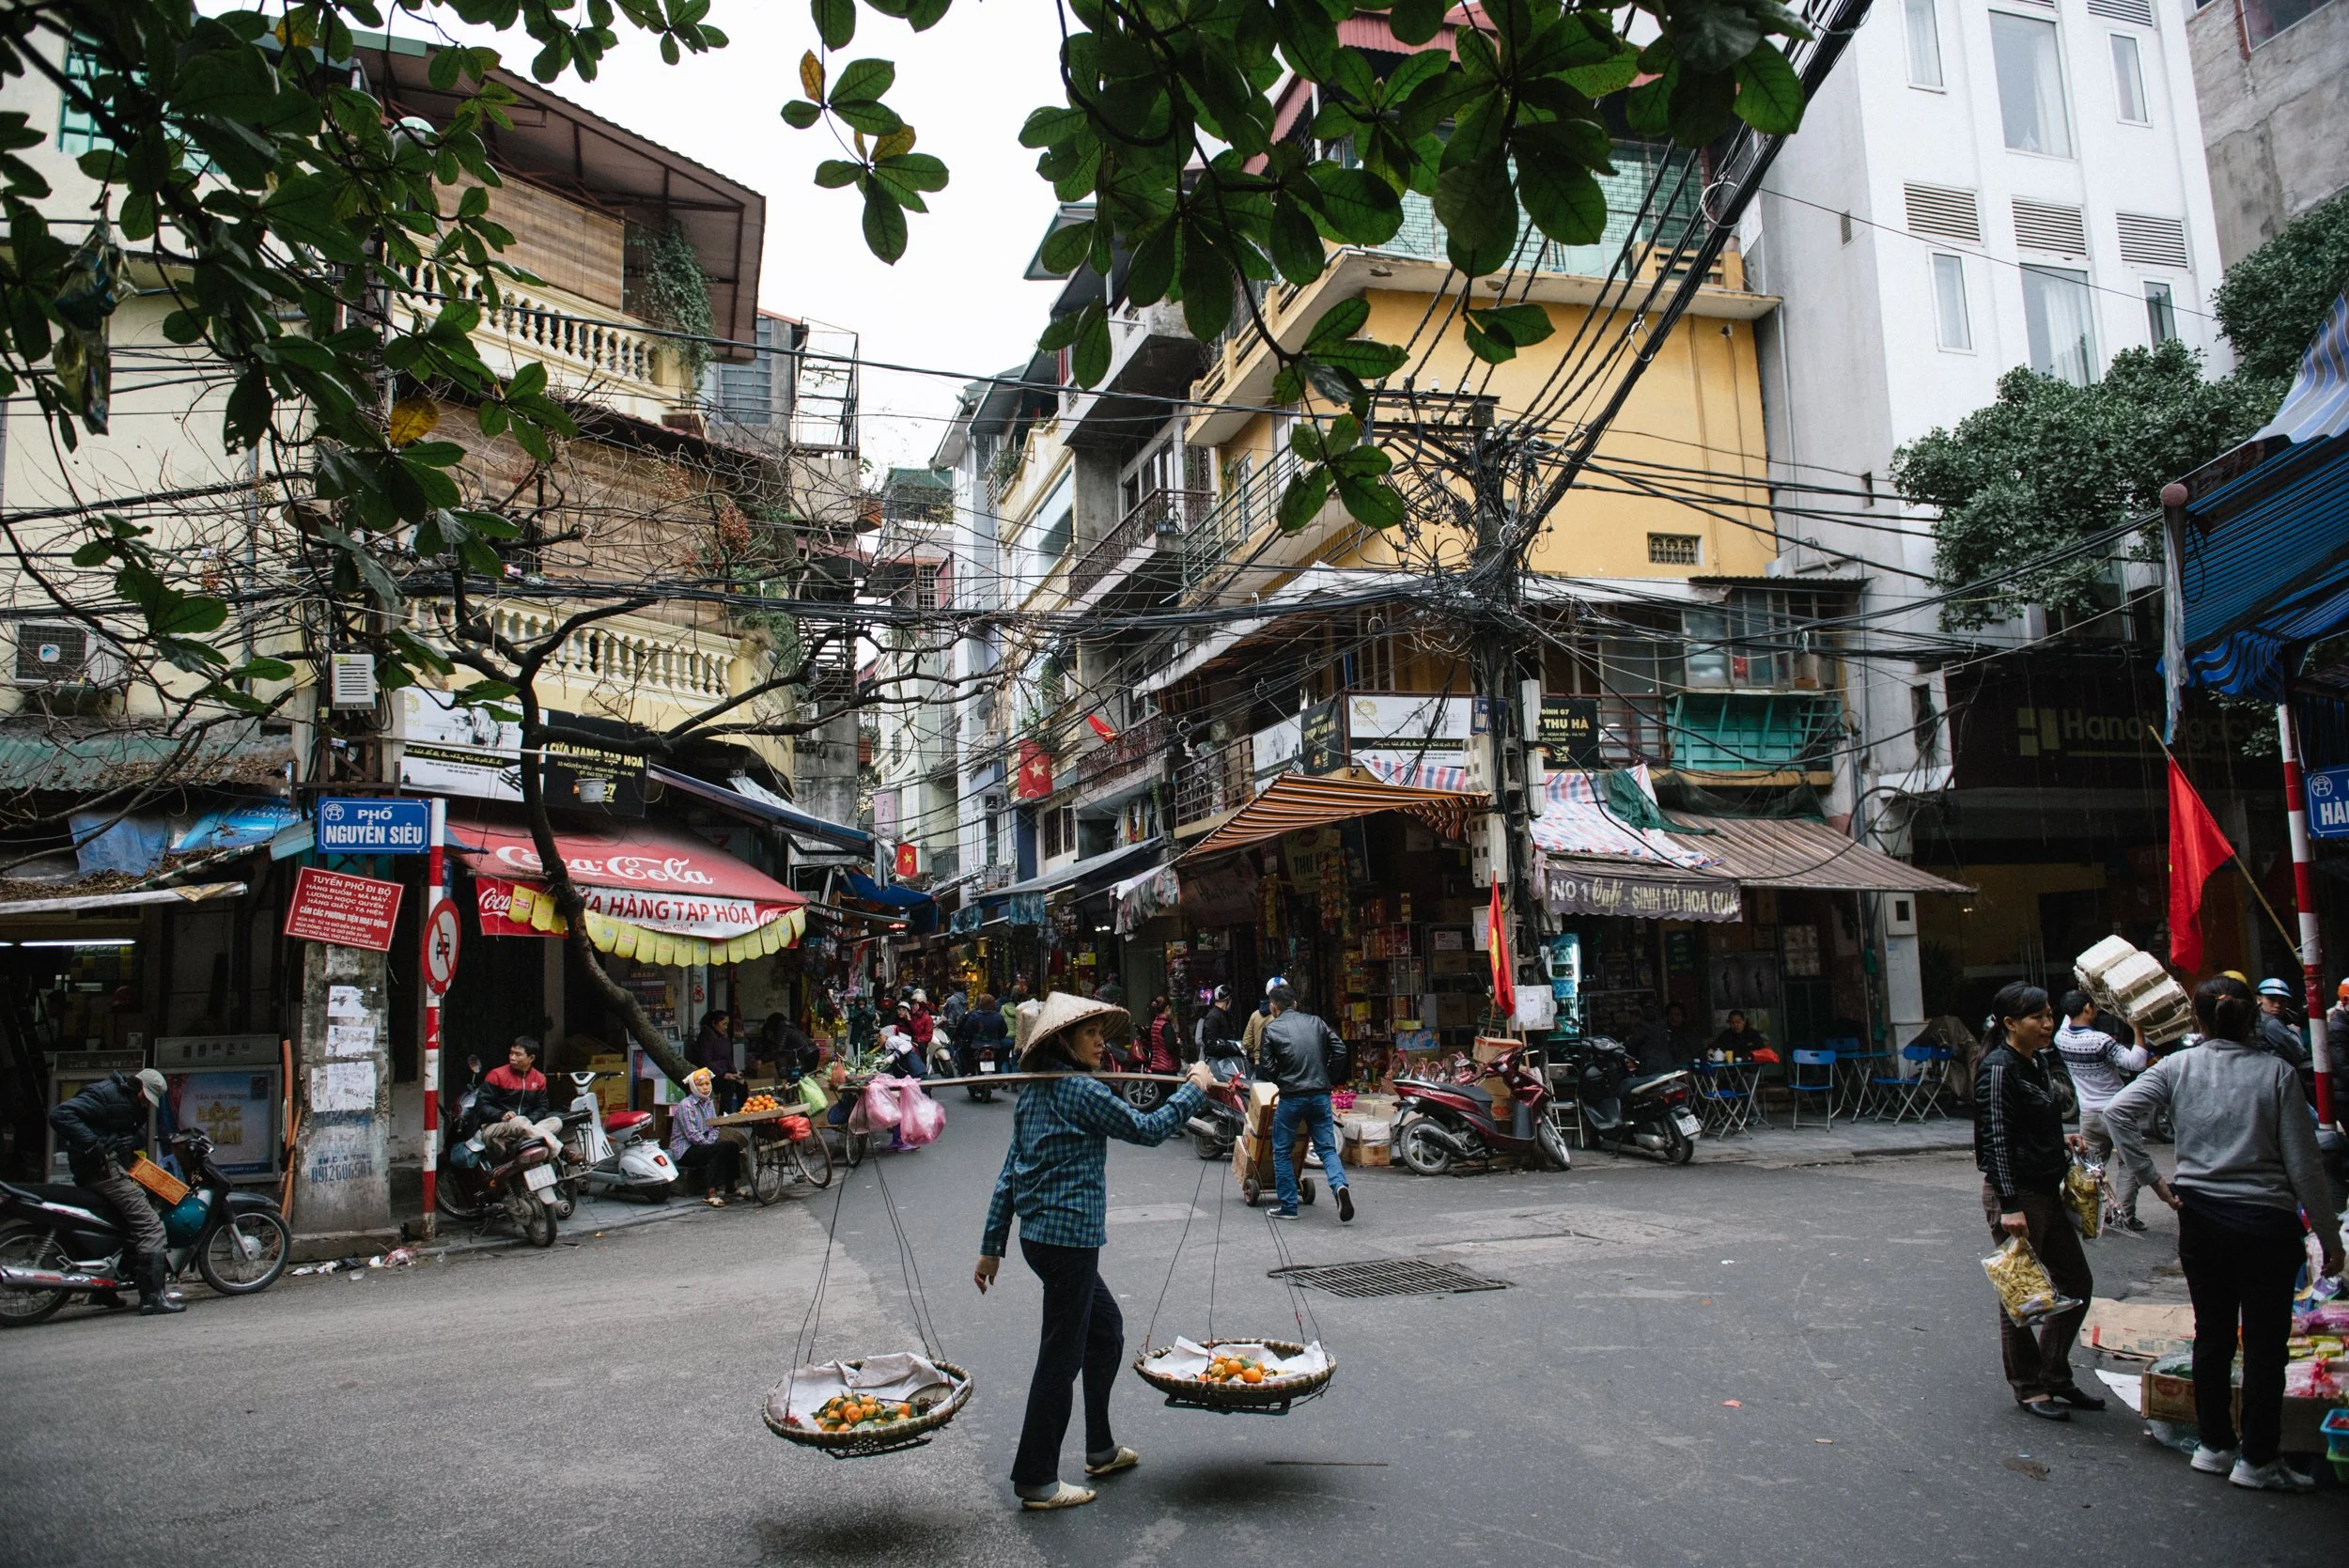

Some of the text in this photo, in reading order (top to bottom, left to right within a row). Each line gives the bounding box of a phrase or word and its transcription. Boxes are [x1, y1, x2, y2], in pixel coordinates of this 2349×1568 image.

[1544, 718, 1568, 729] THU
[1571, 716, 1589, 729] HÀ
[357, 805, 393, 820] PHỐ
[326, 819, 423, 845] NGUYỄN SIÊU
[313, 875, 392, 897] TUYẾN PHỐ ĐI BỘ
[1593, 877, 1624, 914] Café
[1631, 885, 1661, 910] SINH
[1662, 879, 1681, 911] TỐ
[1683, 889, 1709, 914] HOA
[607, 893, 670, 921] HÀNG
[673, 901, 710, 927] TẠP
[714, 902, 754, 925] HÓA
